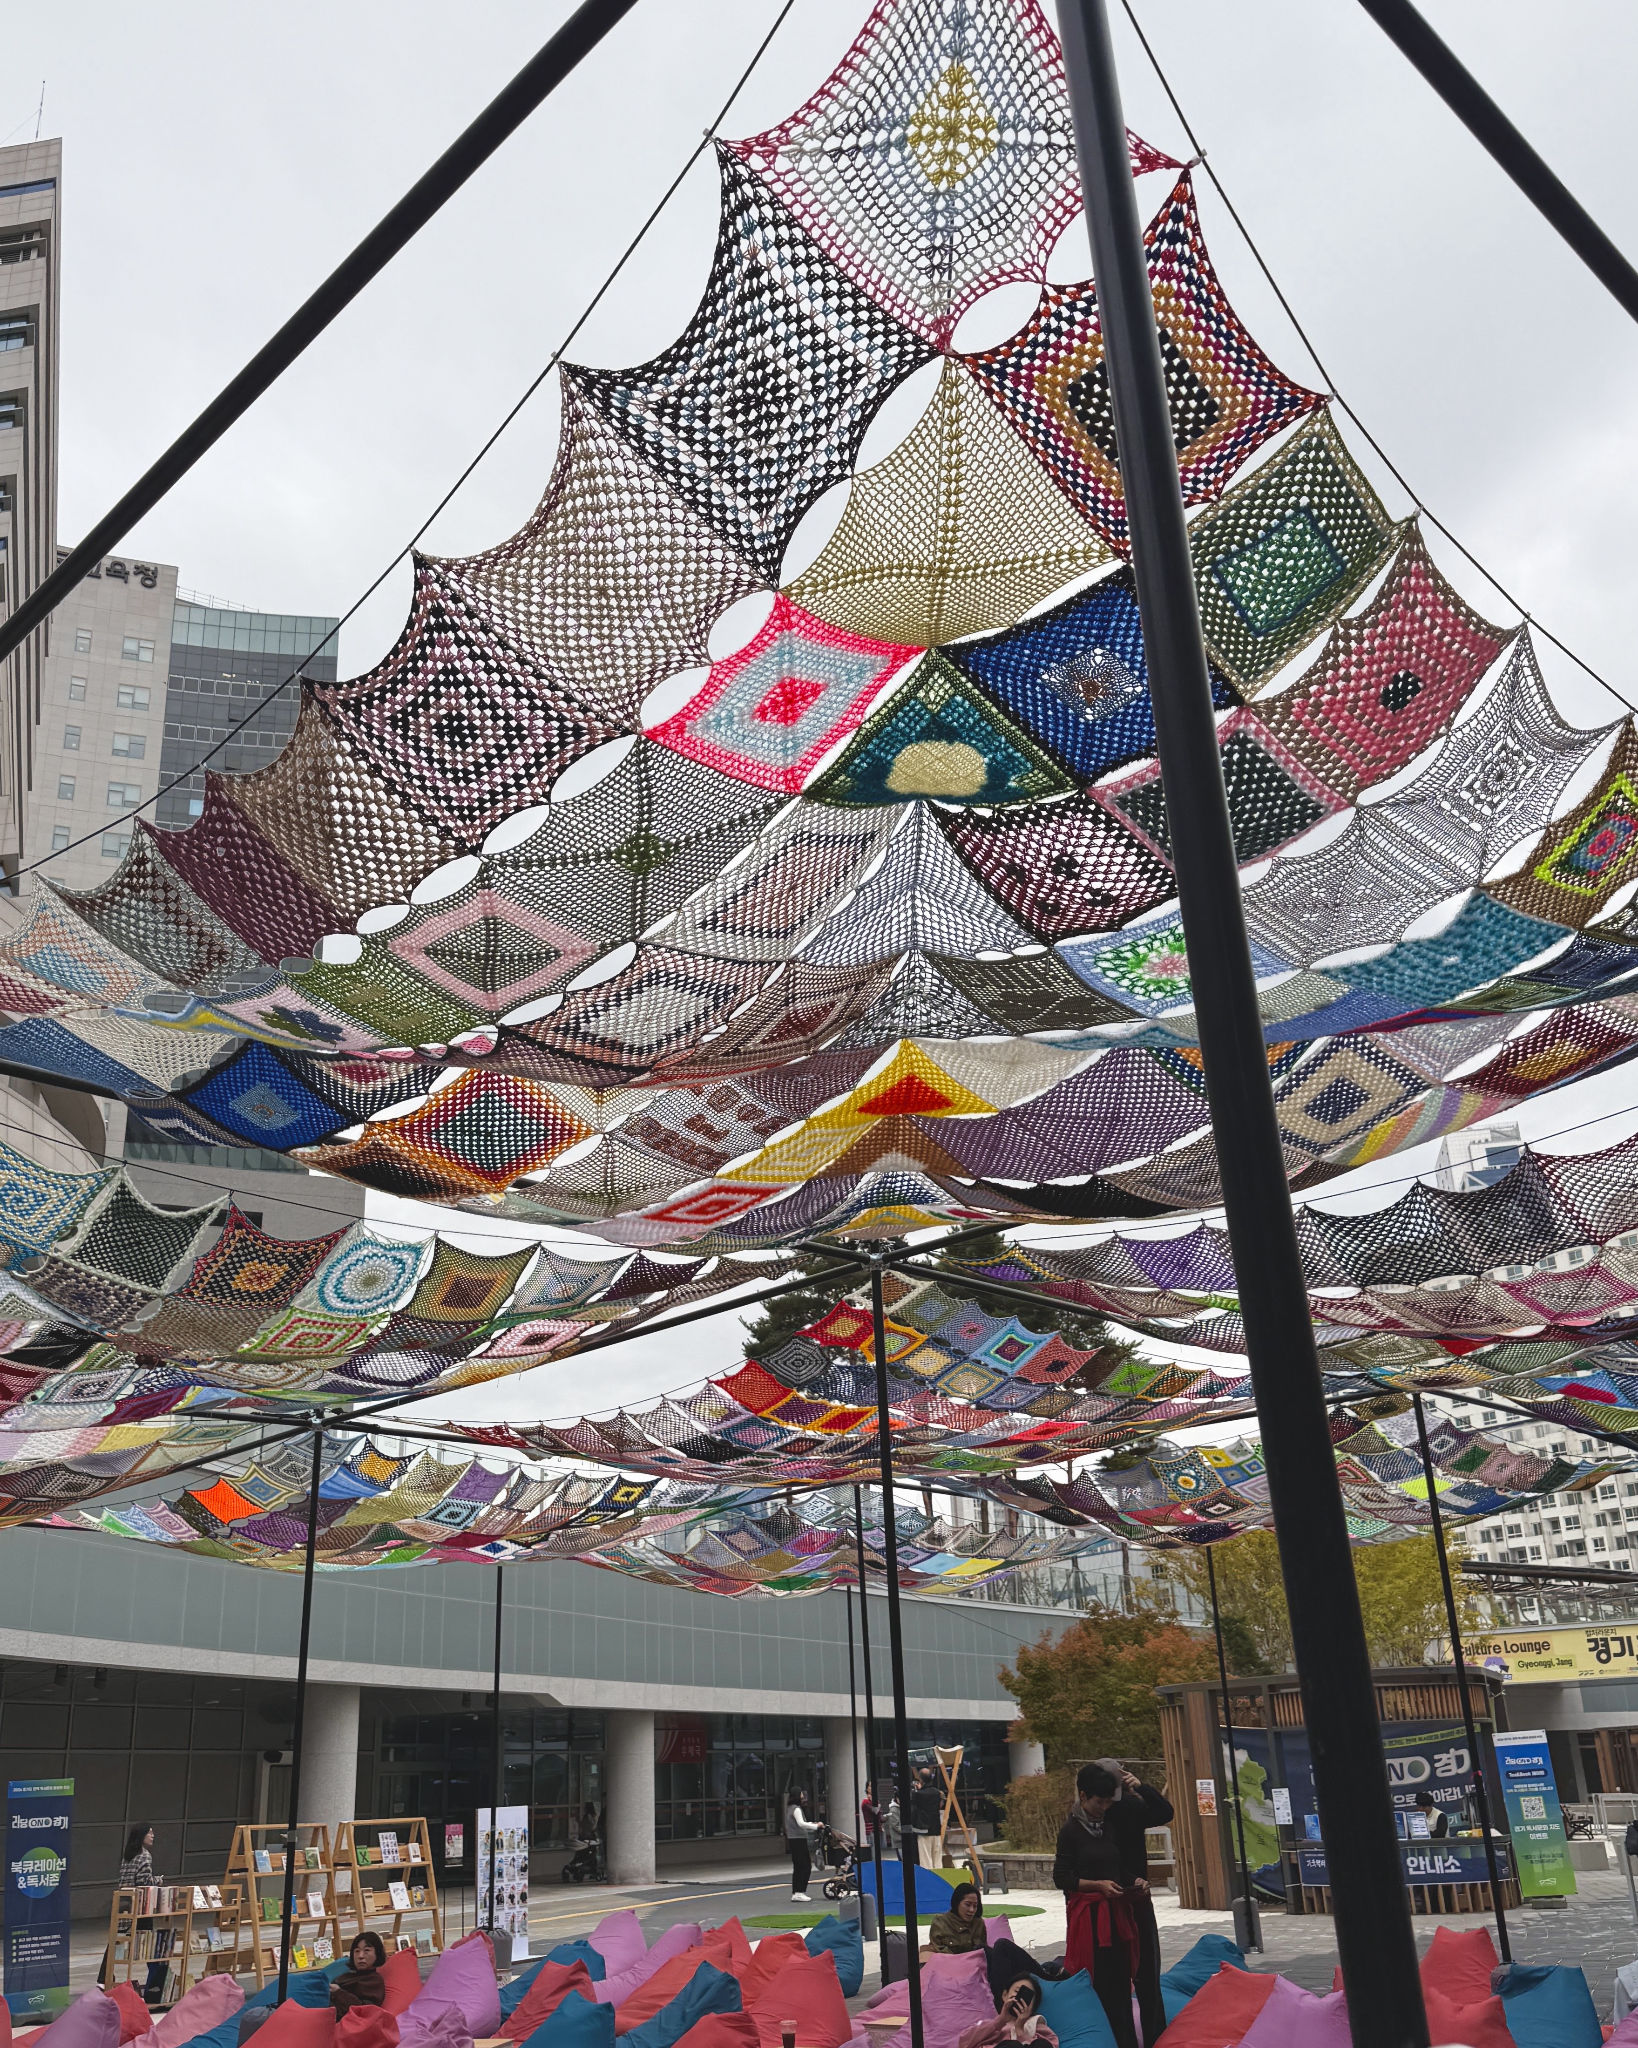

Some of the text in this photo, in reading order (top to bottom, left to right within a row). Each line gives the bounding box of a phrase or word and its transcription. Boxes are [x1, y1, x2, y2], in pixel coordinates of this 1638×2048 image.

[87, 561, 159, 589] 육청
[1504, 1640, 1551, 1655] Lounge
[1433, 1748, 1471, 1778] 경기
[10, 1857, 67, 1874] 북큐레이션
[1405, 1854, 1463, 1876] 안내소
[17, 1873, 60, 1889] &독서존
